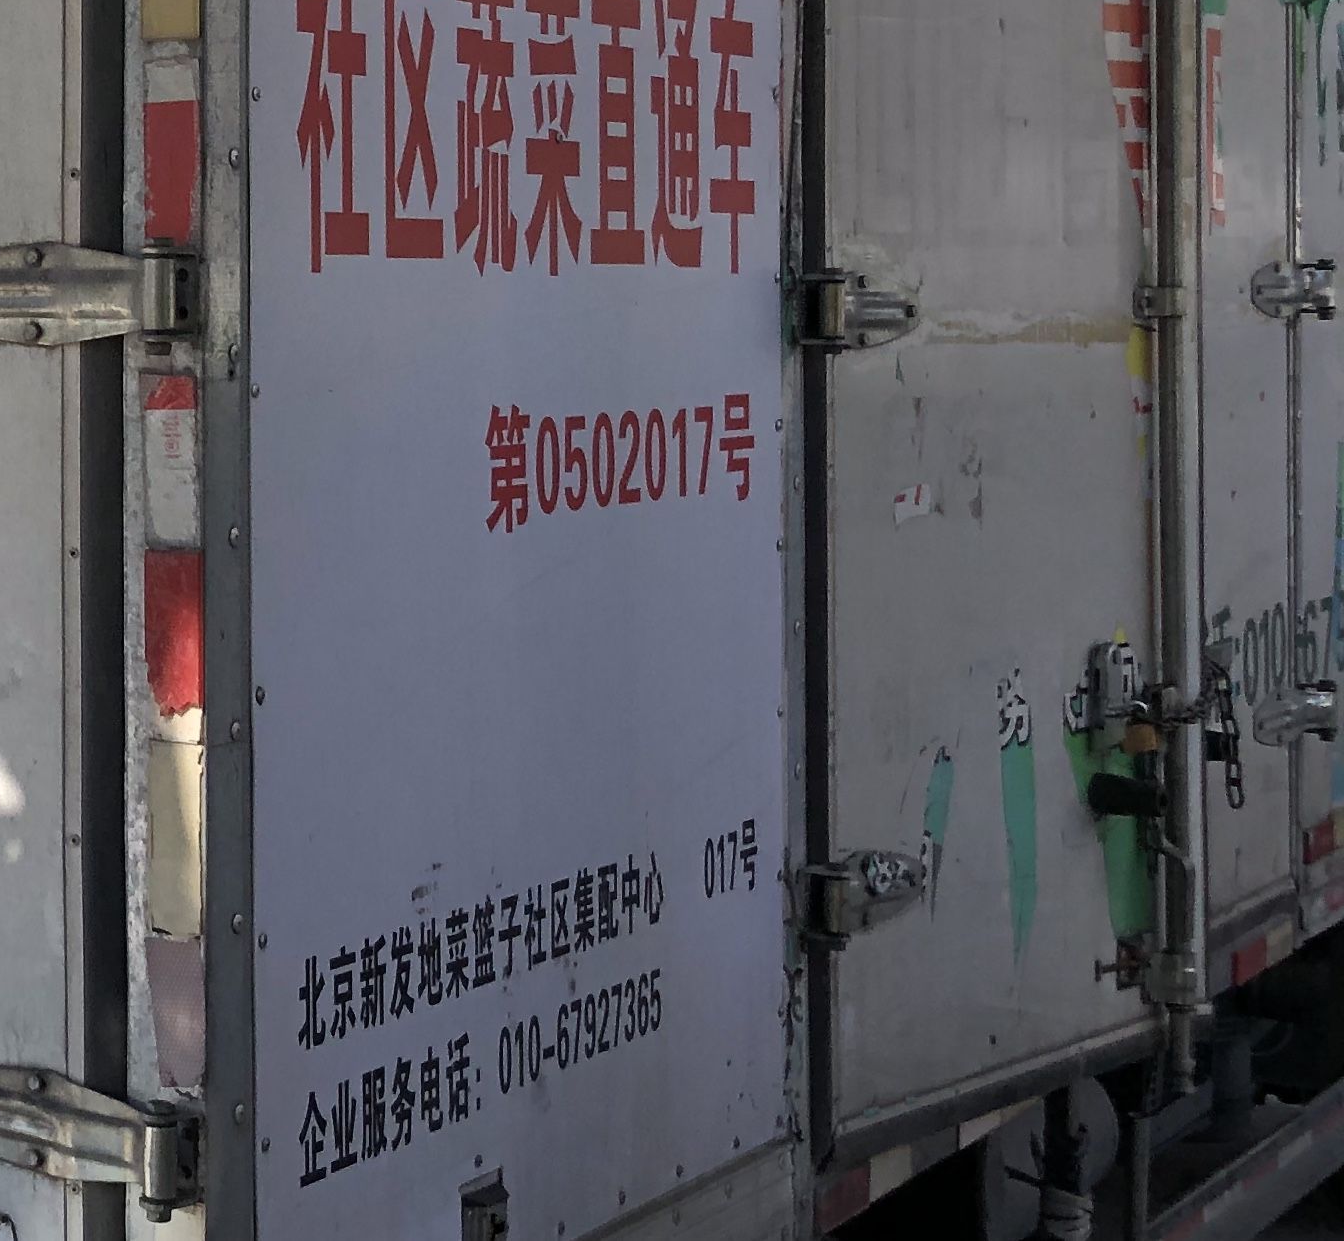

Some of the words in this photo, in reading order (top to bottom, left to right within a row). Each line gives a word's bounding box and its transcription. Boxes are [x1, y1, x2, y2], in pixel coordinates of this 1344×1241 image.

[485, 393, 755, 533] 第0502017号
[298, 850, 664, 1050] 北京新发地菜篮子社区集配中心
[704, 818, 758, 898] 017号
